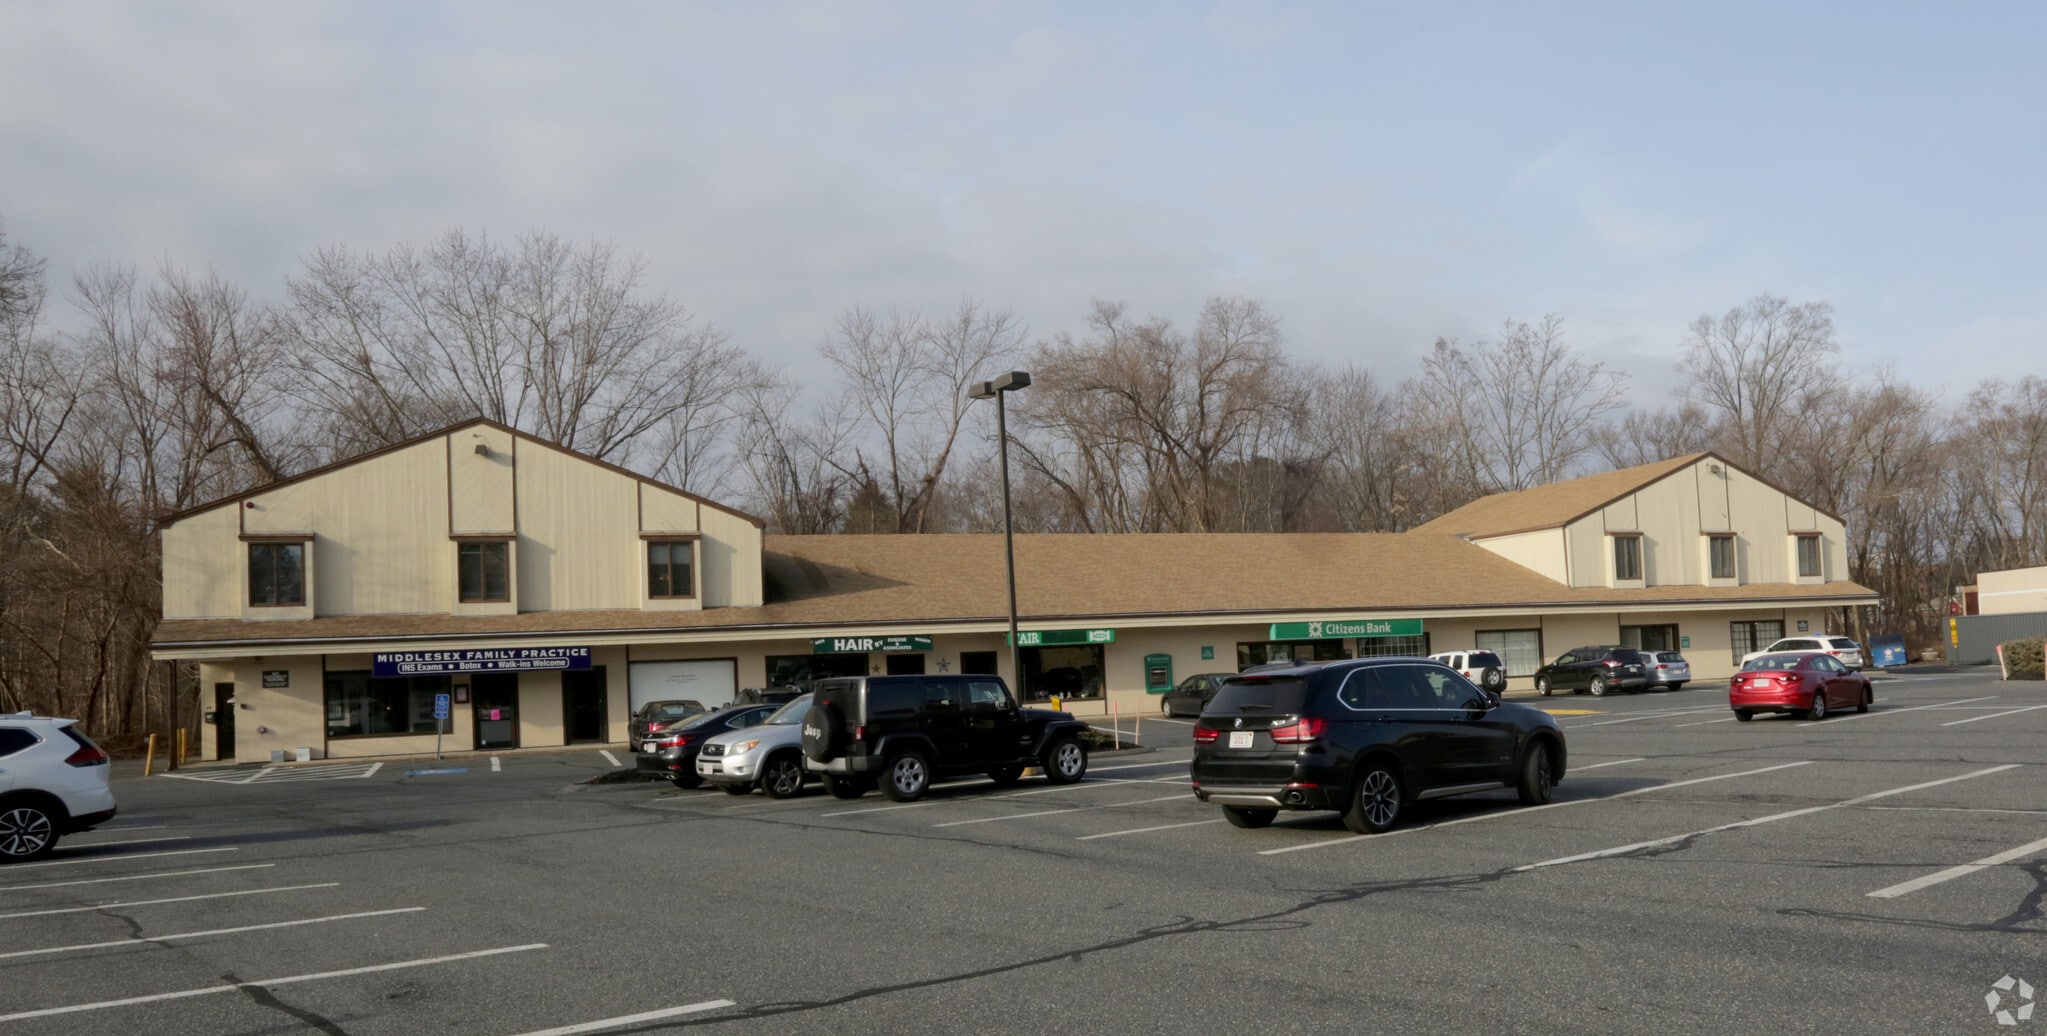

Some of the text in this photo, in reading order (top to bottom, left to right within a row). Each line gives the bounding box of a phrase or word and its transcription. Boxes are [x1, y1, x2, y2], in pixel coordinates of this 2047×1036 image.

[1326, 621, 1391, 635] Citizens Bank
[834, 638, 873, 651] HAIR
[874, 640, 883, 648] BY
[1018, 632, 1040, 644] AIR
[377, 648, 588, 663] MIDDLESEX FAMILY PRACTICE
[401, 658, 566, 672] INS Exams Botox Walk-ins Welcome
[804, 723, 822, 740] Jeep
